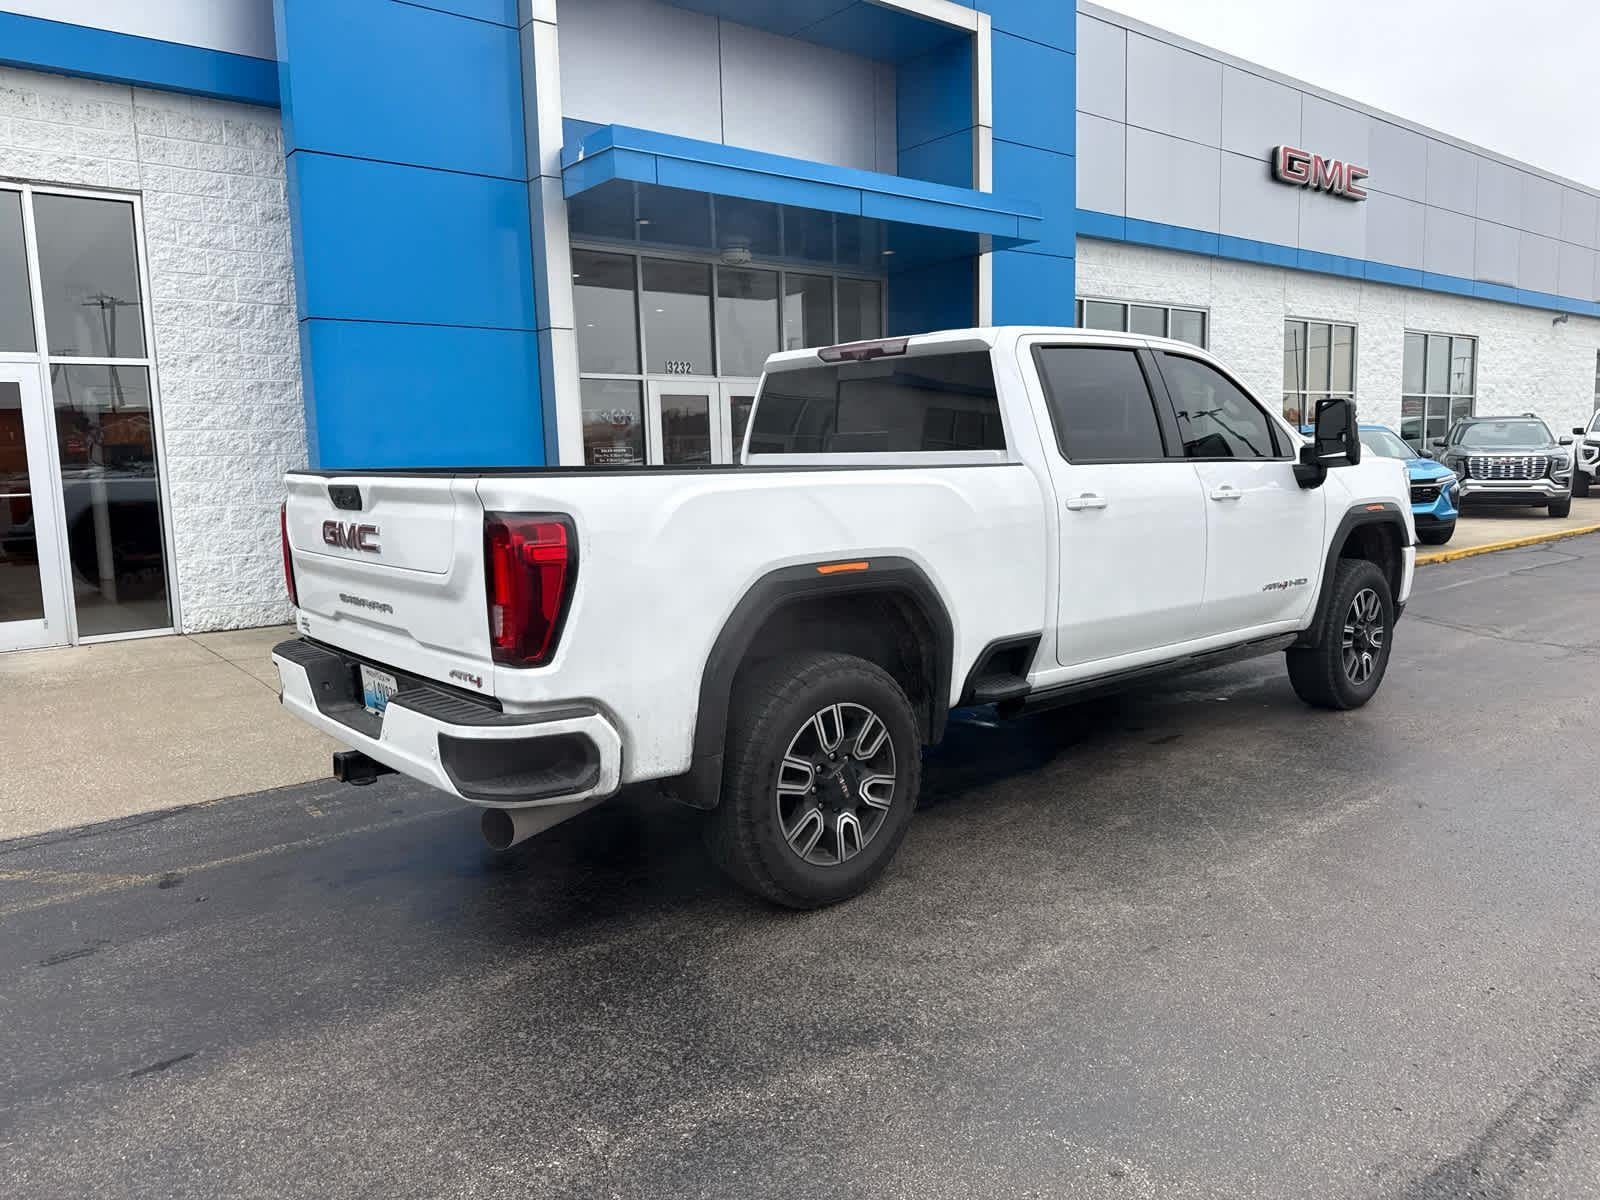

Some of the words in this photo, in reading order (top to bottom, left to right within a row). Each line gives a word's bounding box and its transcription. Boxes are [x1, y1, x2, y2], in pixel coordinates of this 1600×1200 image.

[1273, 145, 1368, 201] GMC
[323, 520, 382, 553] GMC
[339, 593, 393, 614] SIERRA
[449, 669, 482, 688] AT4
